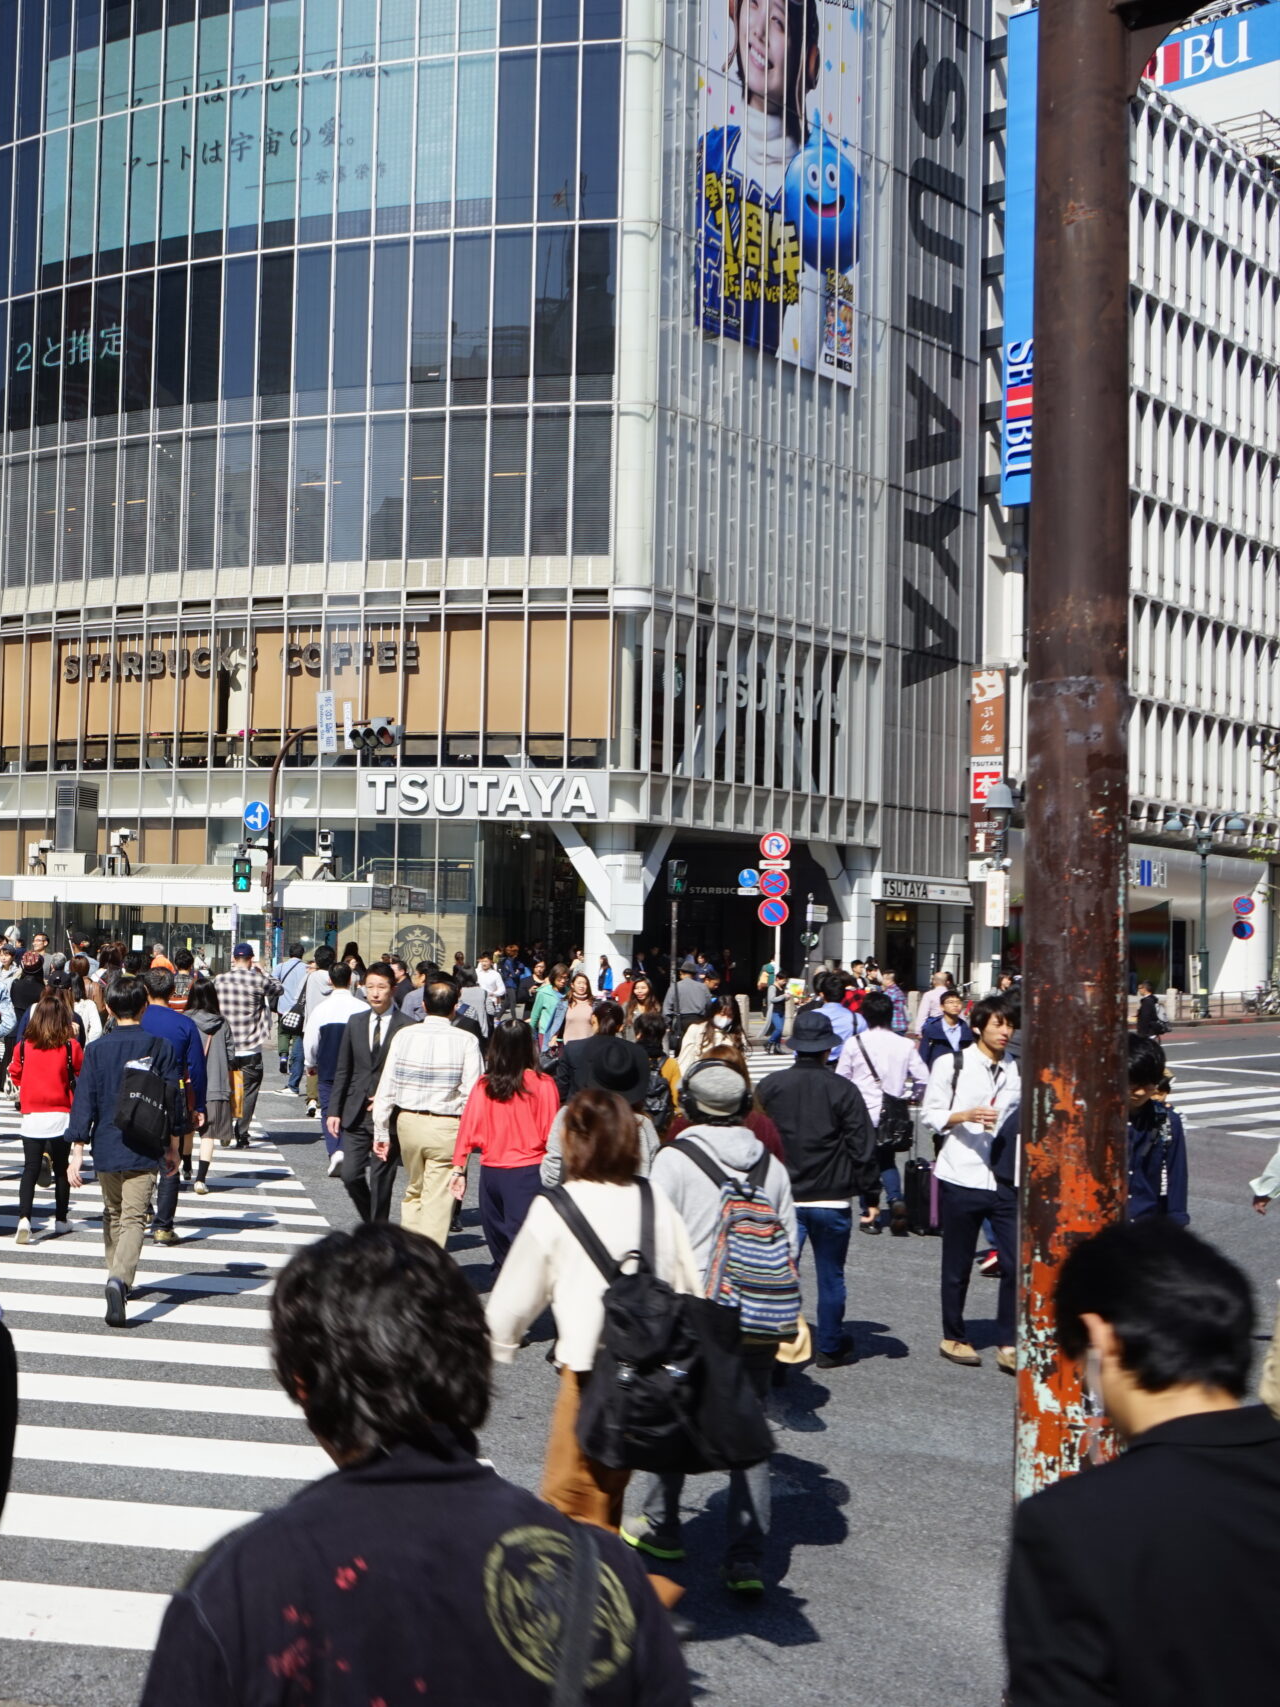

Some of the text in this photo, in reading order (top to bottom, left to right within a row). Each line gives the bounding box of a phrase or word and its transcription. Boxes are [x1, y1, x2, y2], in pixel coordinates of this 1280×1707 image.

[902, 0, 967, 687] SUTAYA
[64, 640, 419, 681] STARBUCKS COFFEE
[367, 774, 597, 815] TSUTAYA
[689, 885, 738, 895] STARBUC
[882, 879, 928, 899] TSUTAYA
